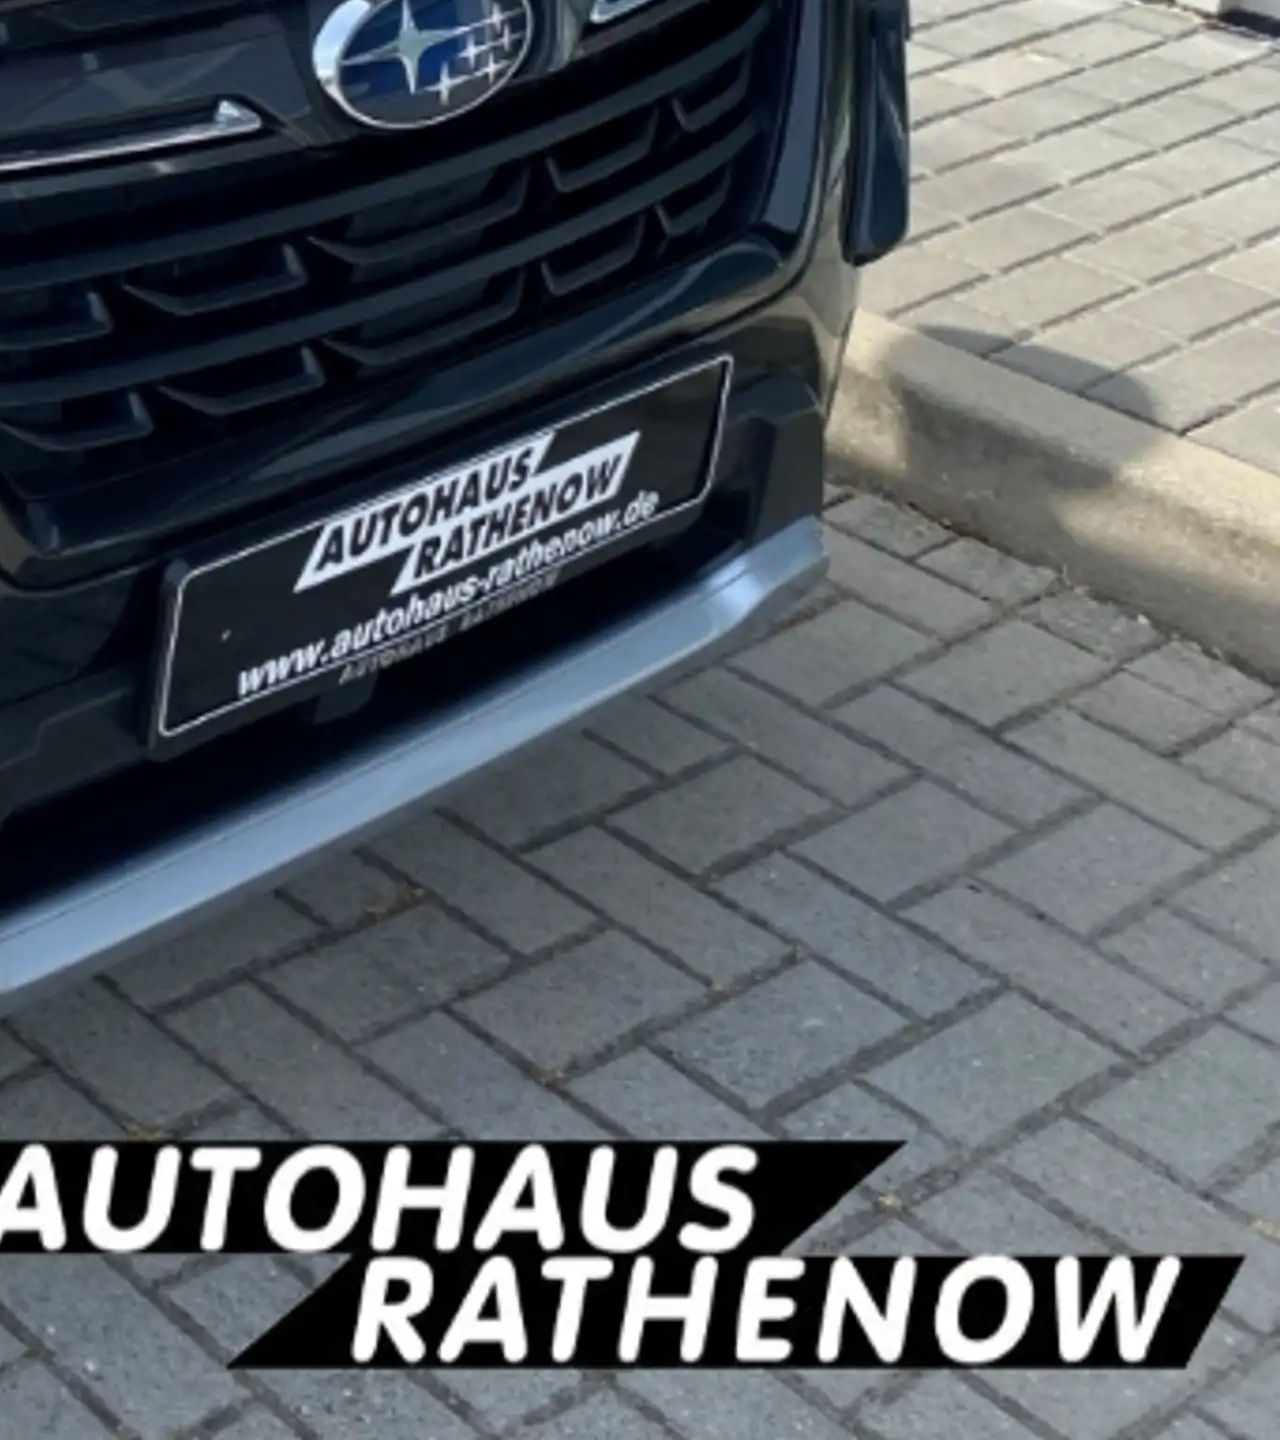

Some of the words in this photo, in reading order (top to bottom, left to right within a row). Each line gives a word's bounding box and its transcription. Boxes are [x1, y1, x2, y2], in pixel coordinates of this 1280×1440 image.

[313, 446, 535, 573] AUTOHAUS
[412, 452, 624, 581] RATHENOW
[237, 489, 660, 696] www.autohaus-rathenow.de
